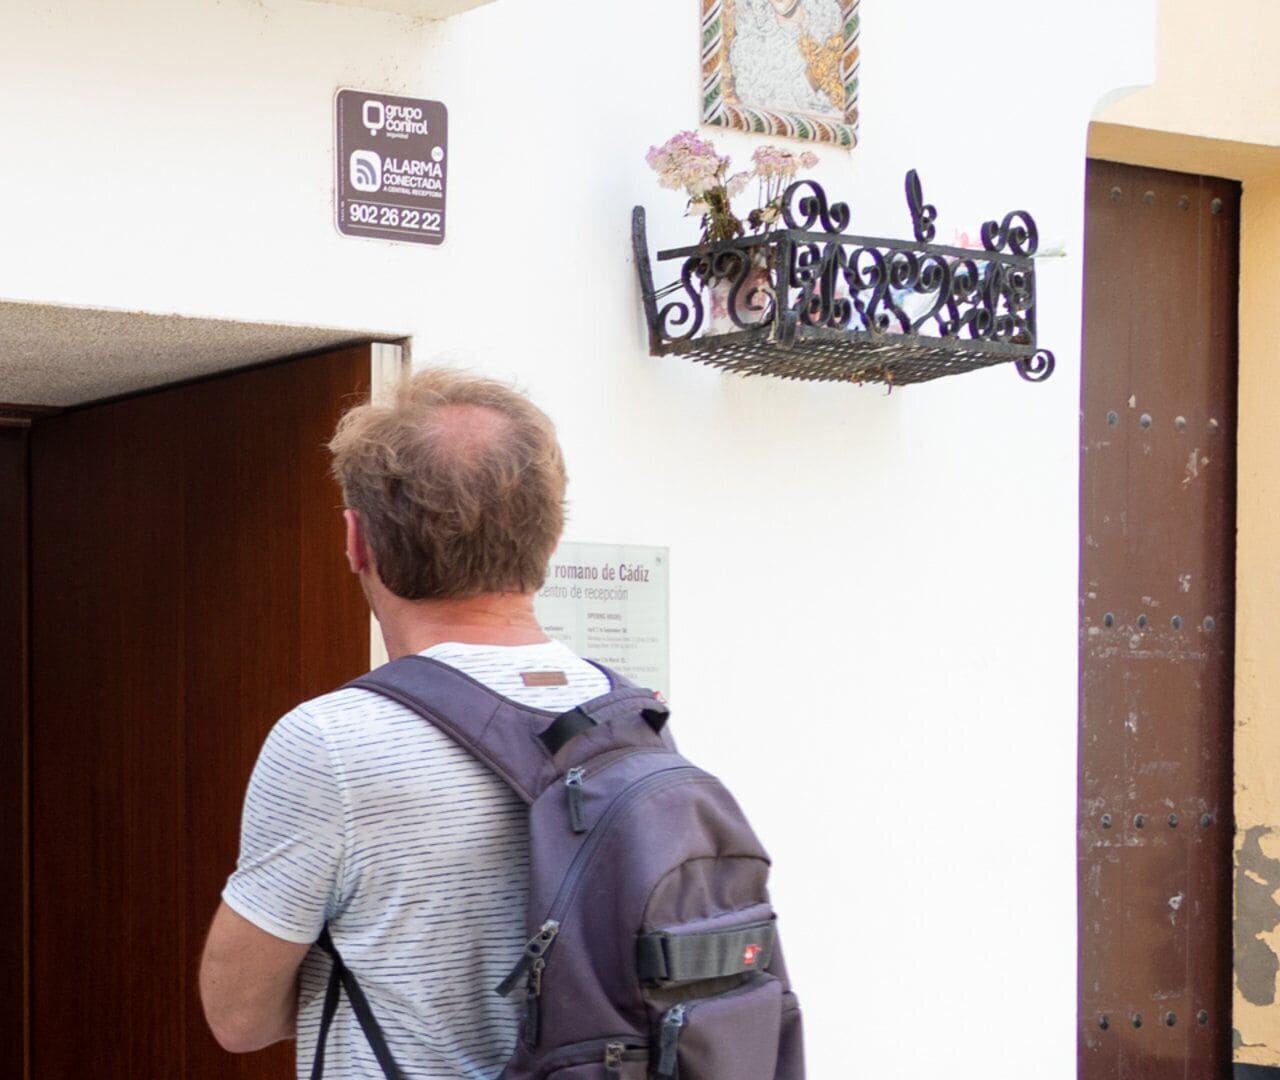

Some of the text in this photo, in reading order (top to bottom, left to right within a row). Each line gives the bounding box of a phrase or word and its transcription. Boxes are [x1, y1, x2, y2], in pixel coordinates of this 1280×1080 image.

[385, 104, 423, 122] grupo
[385, 117, 429, 135] control
[383, 157, 443, 178] ALARMA
[383, 173, 443, 190] CONECTADA
[349, 203, 441, 231] 902 26 22 22
[554, 564, 599, 580] romano
[601, 563, 616, 581] de
[618, 563, 650, 583] Cádiz
[570, 584, 583, 600] de
[584, 585, 629, 602] recepción
